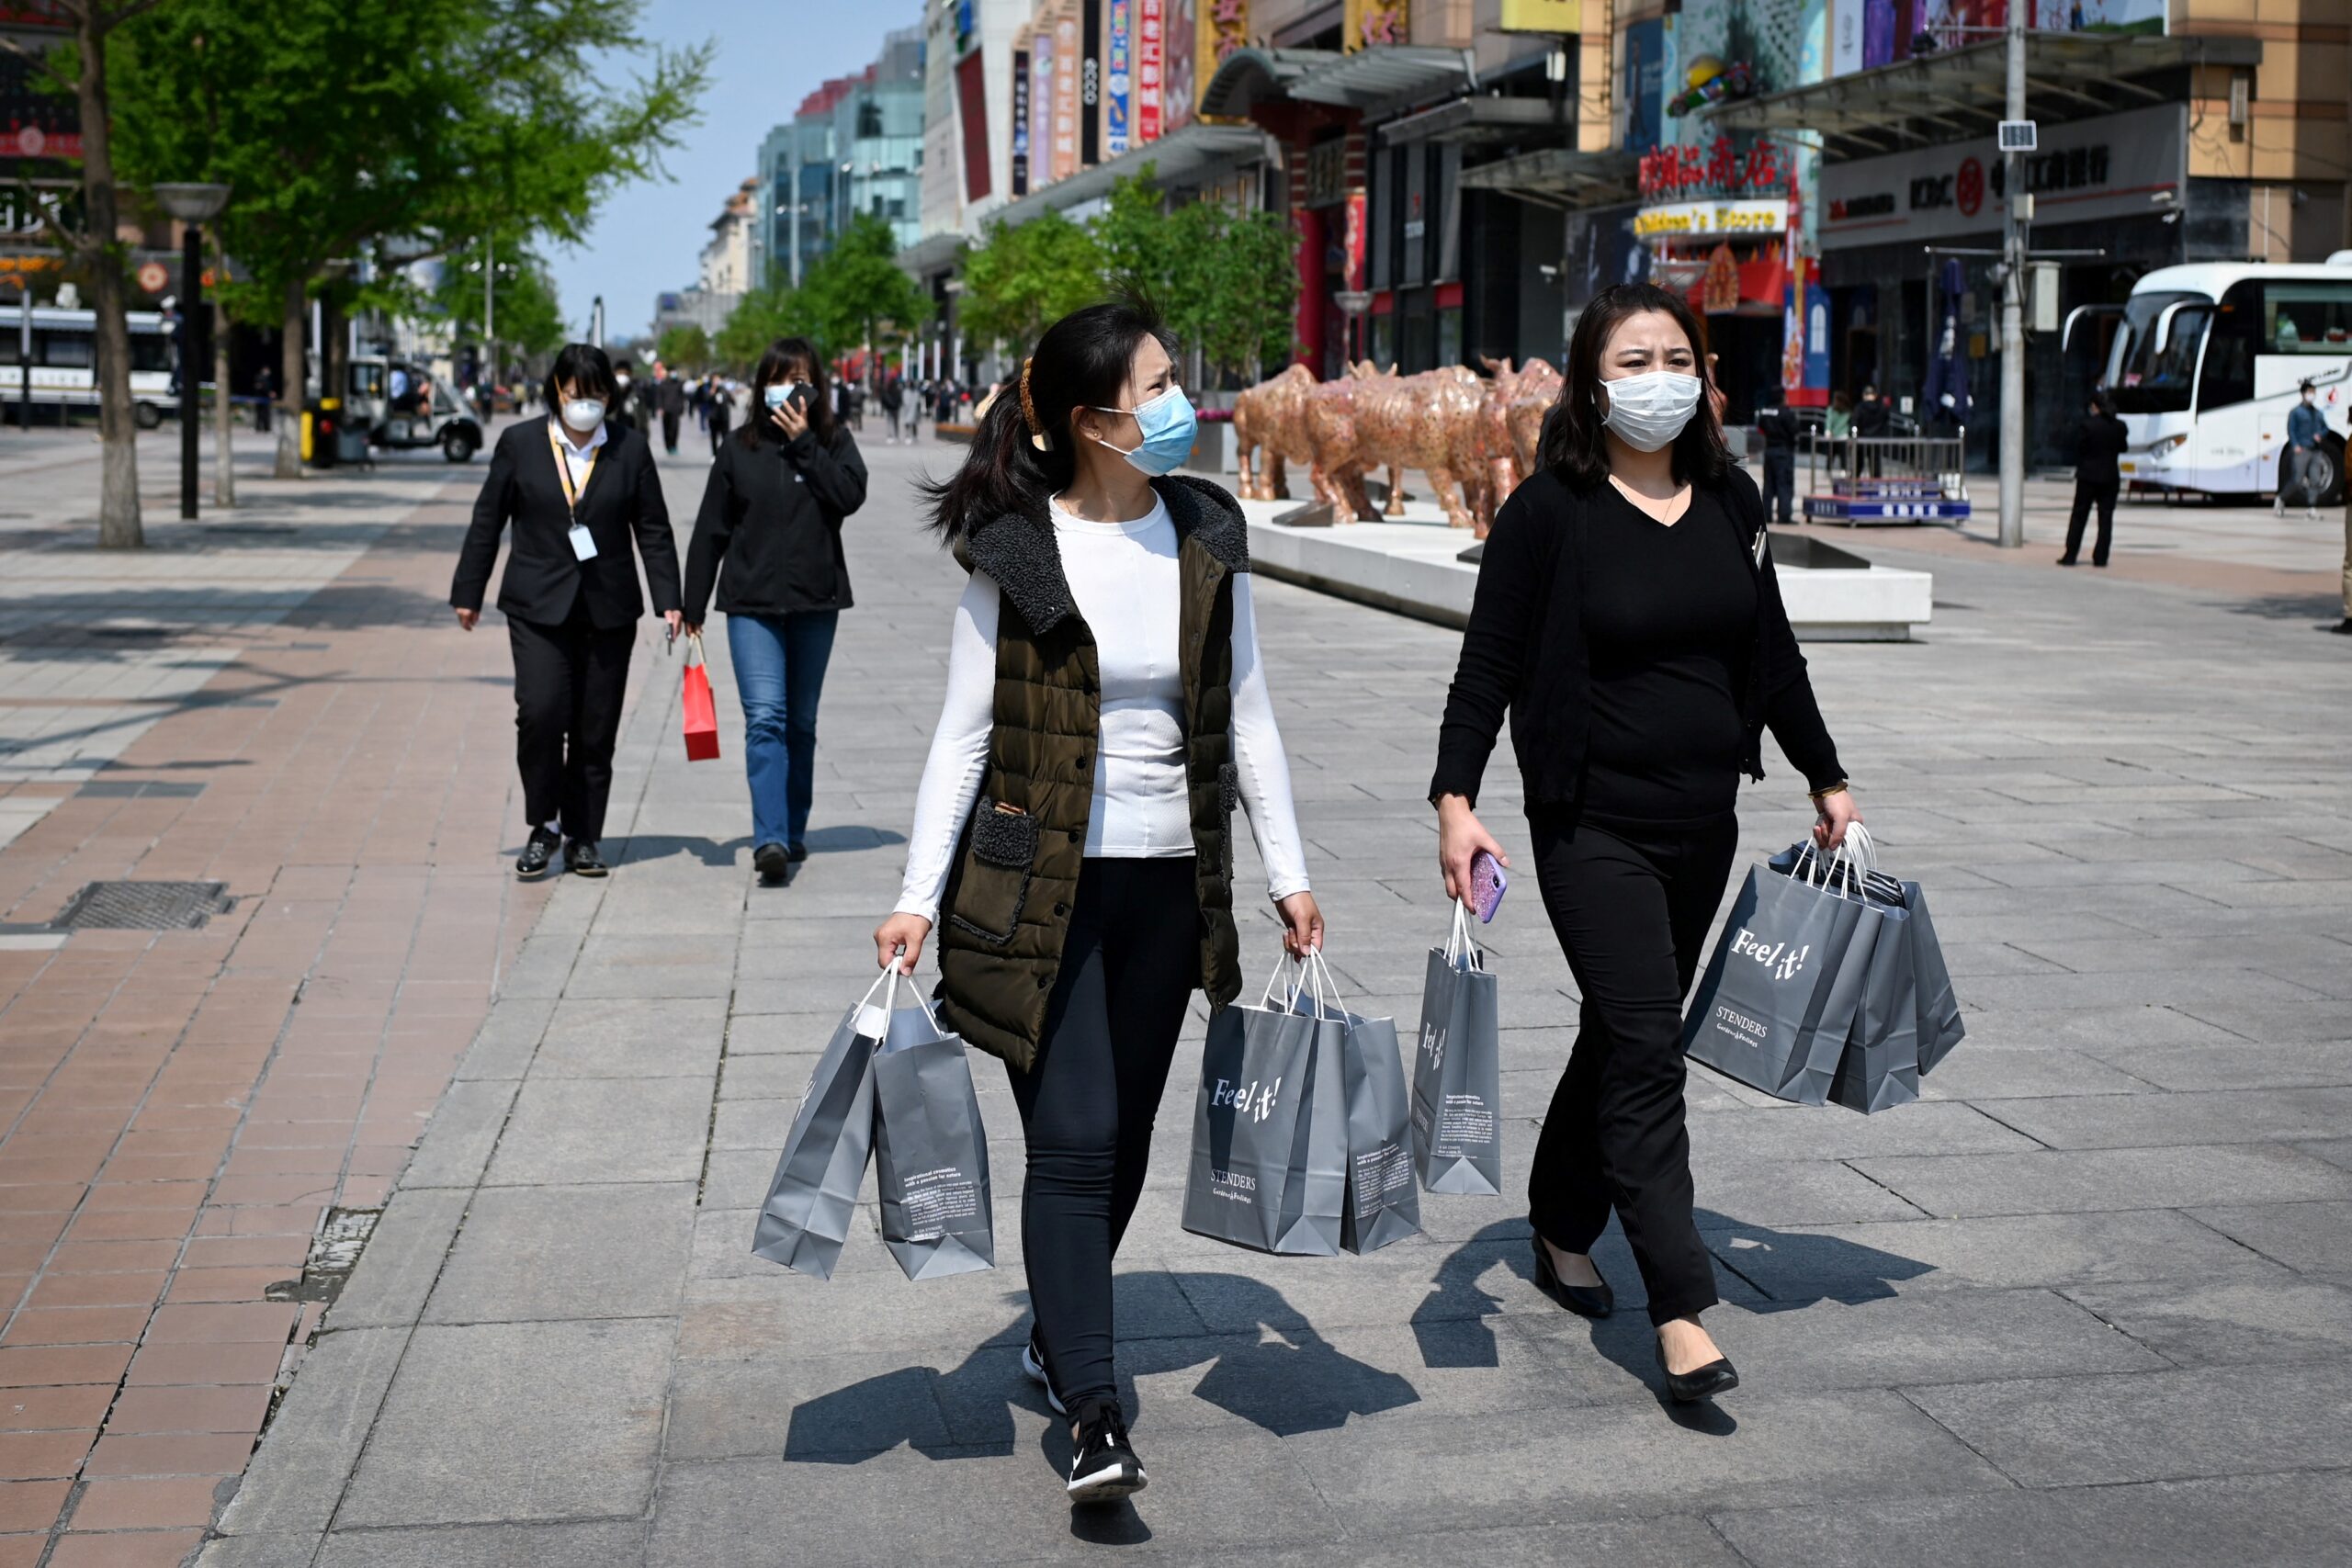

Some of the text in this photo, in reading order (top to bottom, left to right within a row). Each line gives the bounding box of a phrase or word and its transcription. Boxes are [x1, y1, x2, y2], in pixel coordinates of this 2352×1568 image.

[1714, 207, 1776, 229] Store
[1731, 929, 1810, 980] Feel it!
[1716, 1006, 1768, 1038] STENDERS
[1211, 1077, 1282, 1124] Feel it!
[1210, 1168, 1256, 1191] STENDERS
